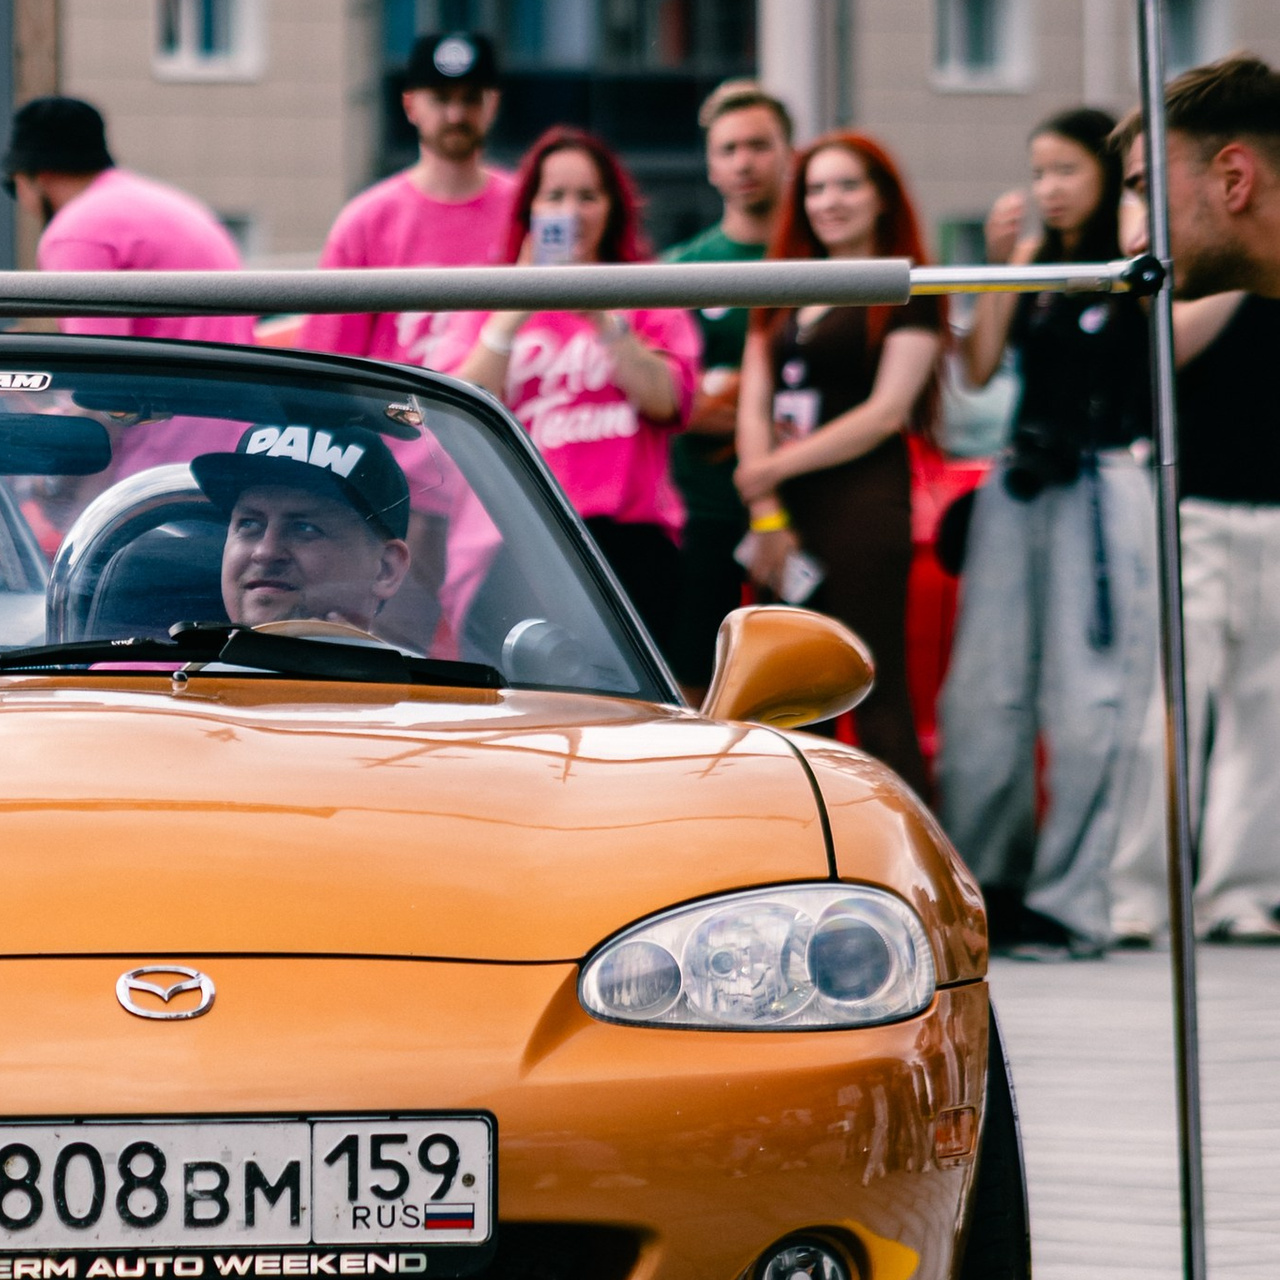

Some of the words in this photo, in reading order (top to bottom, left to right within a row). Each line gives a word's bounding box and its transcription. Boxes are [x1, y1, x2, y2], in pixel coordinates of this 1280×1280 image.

[245, 425, 364, 479] PAW
[323, 1133, 462, 1202] 159
[352, 1204, 422, 1230] RUS
[86, 1255, 205, 1279] AUTO
[214, 1252, 428, 1276] WEEKEND
